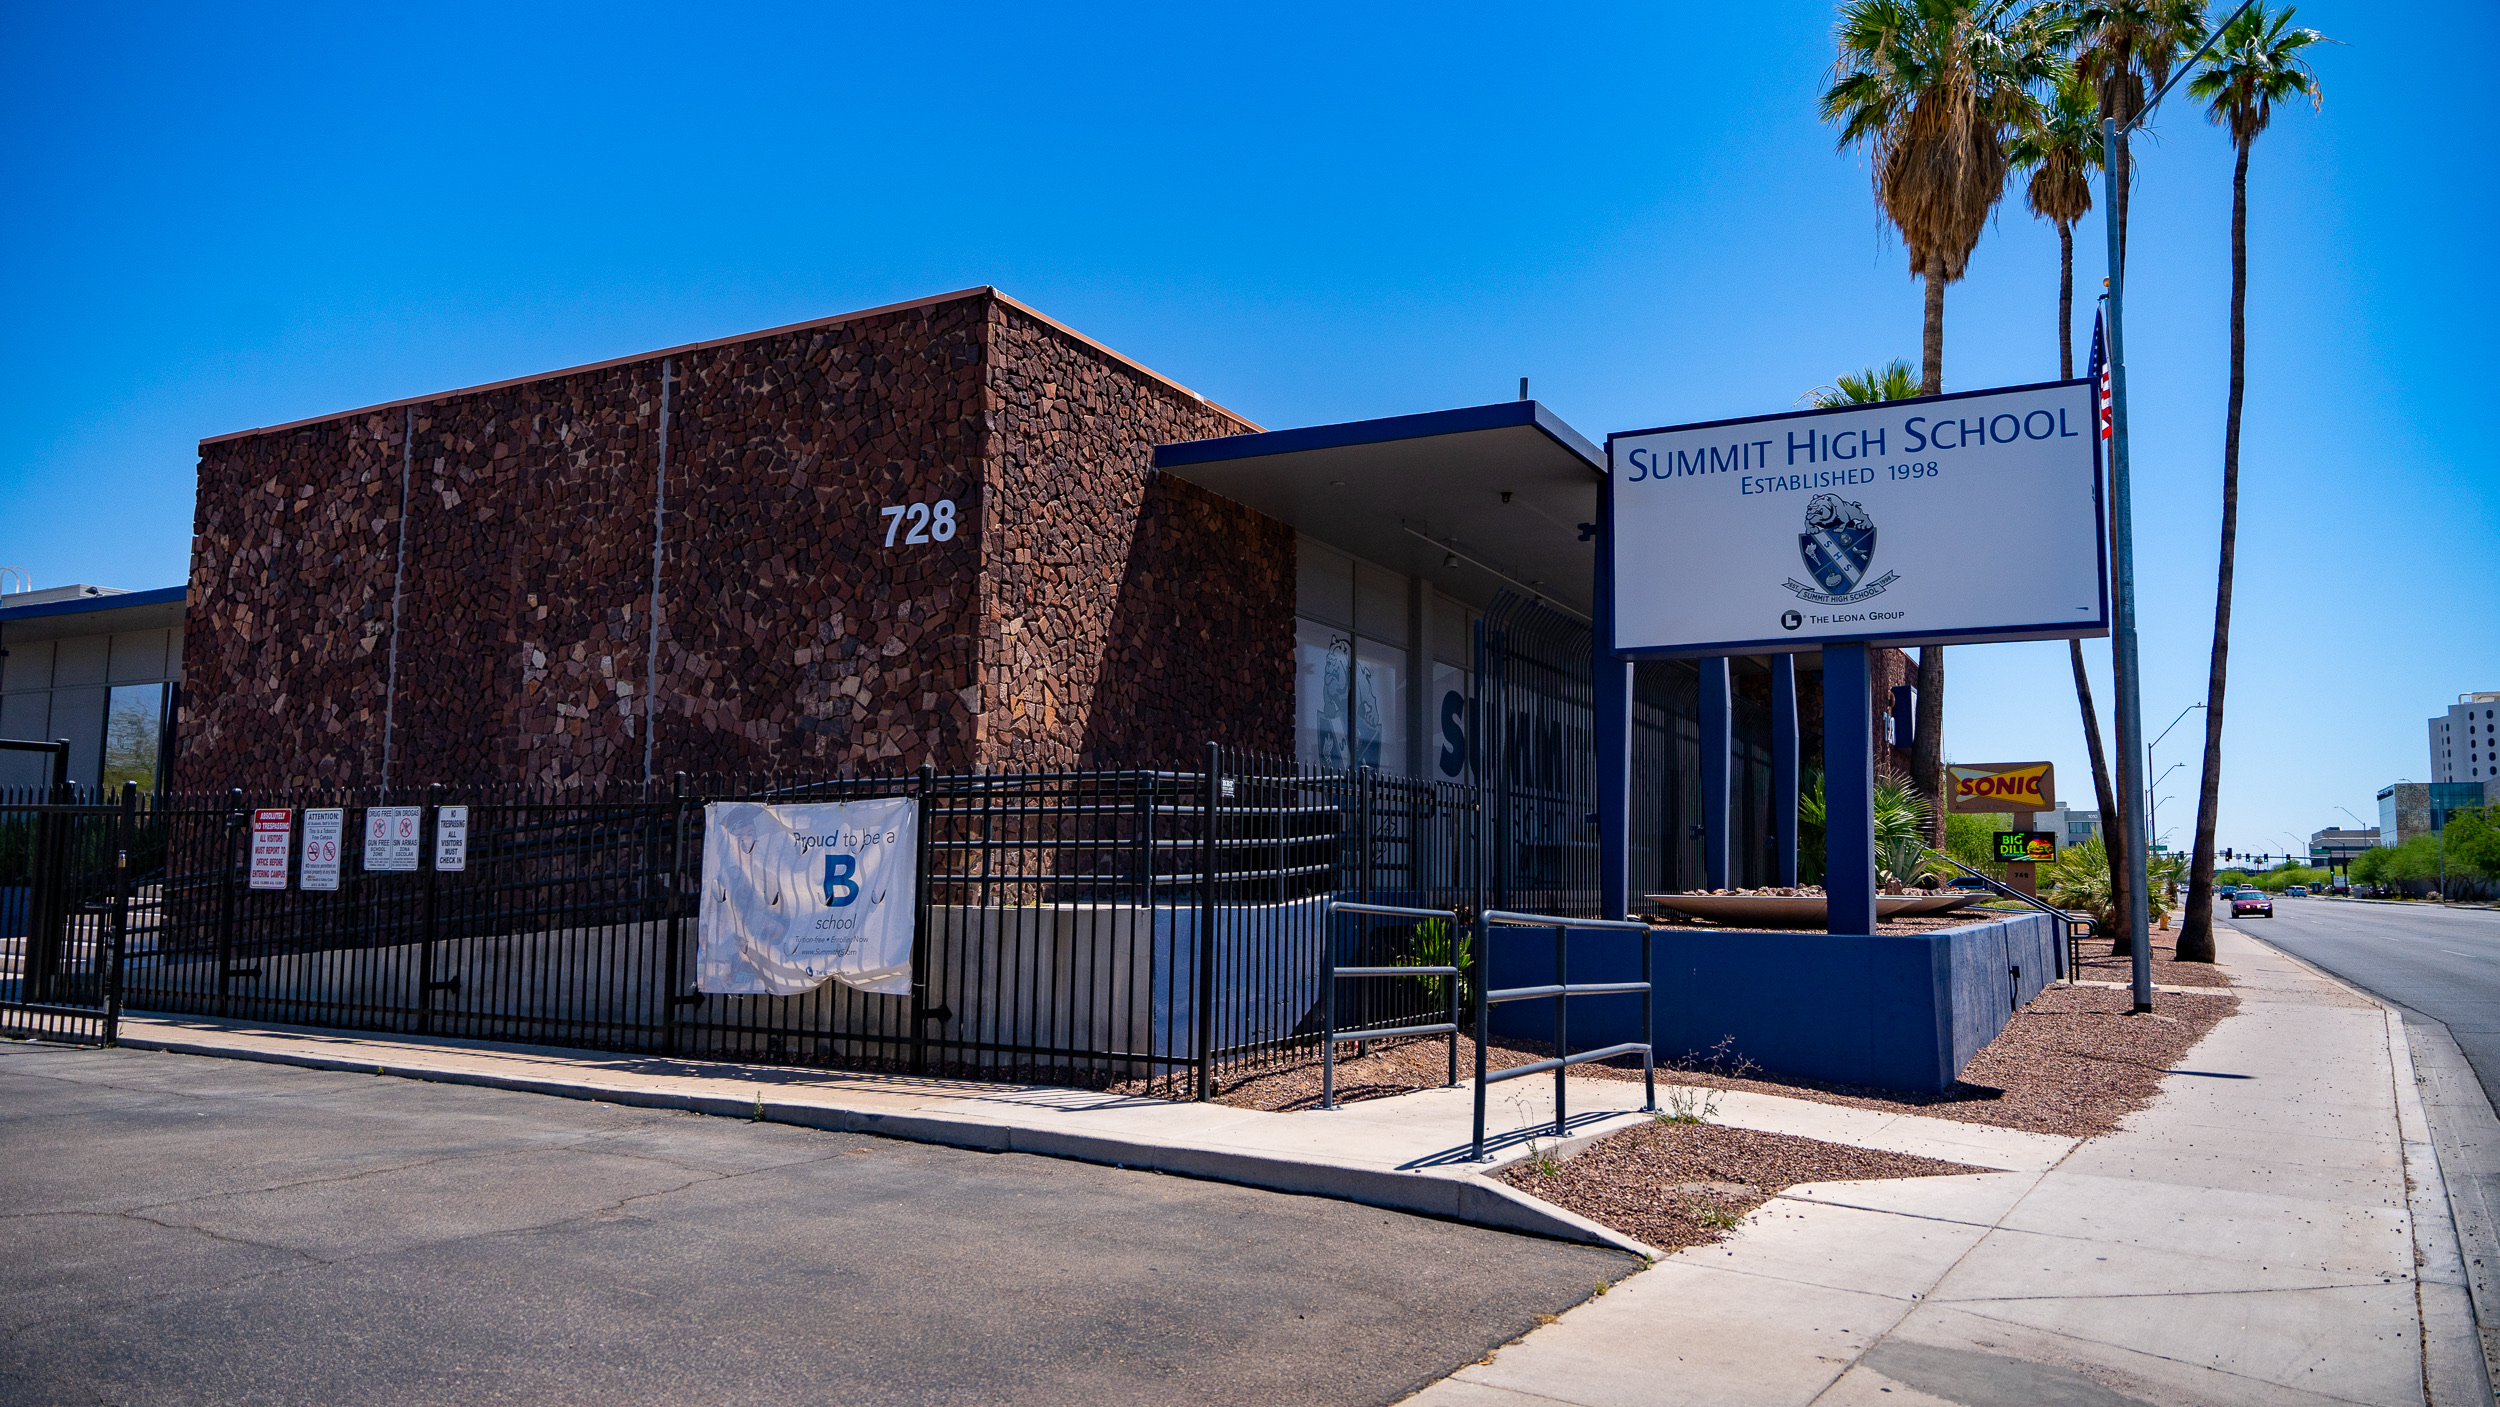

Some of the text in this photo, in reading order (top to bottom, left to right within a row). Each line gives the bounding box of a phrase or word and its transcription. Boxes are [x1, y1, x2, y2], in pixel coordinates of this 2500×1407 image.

[1628, 408, 2078, 482] SUMMIT HIGH SCHOOL
[1741, 461, 1939, 495] ESTABLISHED 1998
[882, 499, 957, 547] 728
[1802, 591, 1829, 602] SUMMIT
[1850, 587, 1879, 601] SCHOOL
[1810, 615, 1829, 624] THE
[1832, 613, 1866, 623] LEONA
[1869, 611, 1905, 621] GROUP
[1960, 776, 2042, 796] SONIC
[260, 812, 286, 820] ABSOLUTELY
[308, 813, 340, 821] ATTENTION:
[369, 810, 392, 818] DRUG FREE
[451, 810, 457, 818] NO
[255, 822, 290, 830] NO TRESPASSING
[441, 820, 465, 828] TRESPASSING
[267, 835, 283, 843] VISITORS
[793, 828, 895, 848] Proud to be a
[2002, 835, 2023, 845] BIG
[367, 839, 390, 847] GUN FREE
[255, 846, 286, 855] MUST REPORT TO
[445, 848, 458, 856] MUST
[2000, 845, 2026, 854] DILL
[256, 858, 283, 867] OFFICE BEFORE
[252, 870, 286, 879] ENTERING CAMPUS
[823, 854, 860, 908] B
[815, 913, 857, 930] school
[795, 936, 825, 944] Tuition-free
